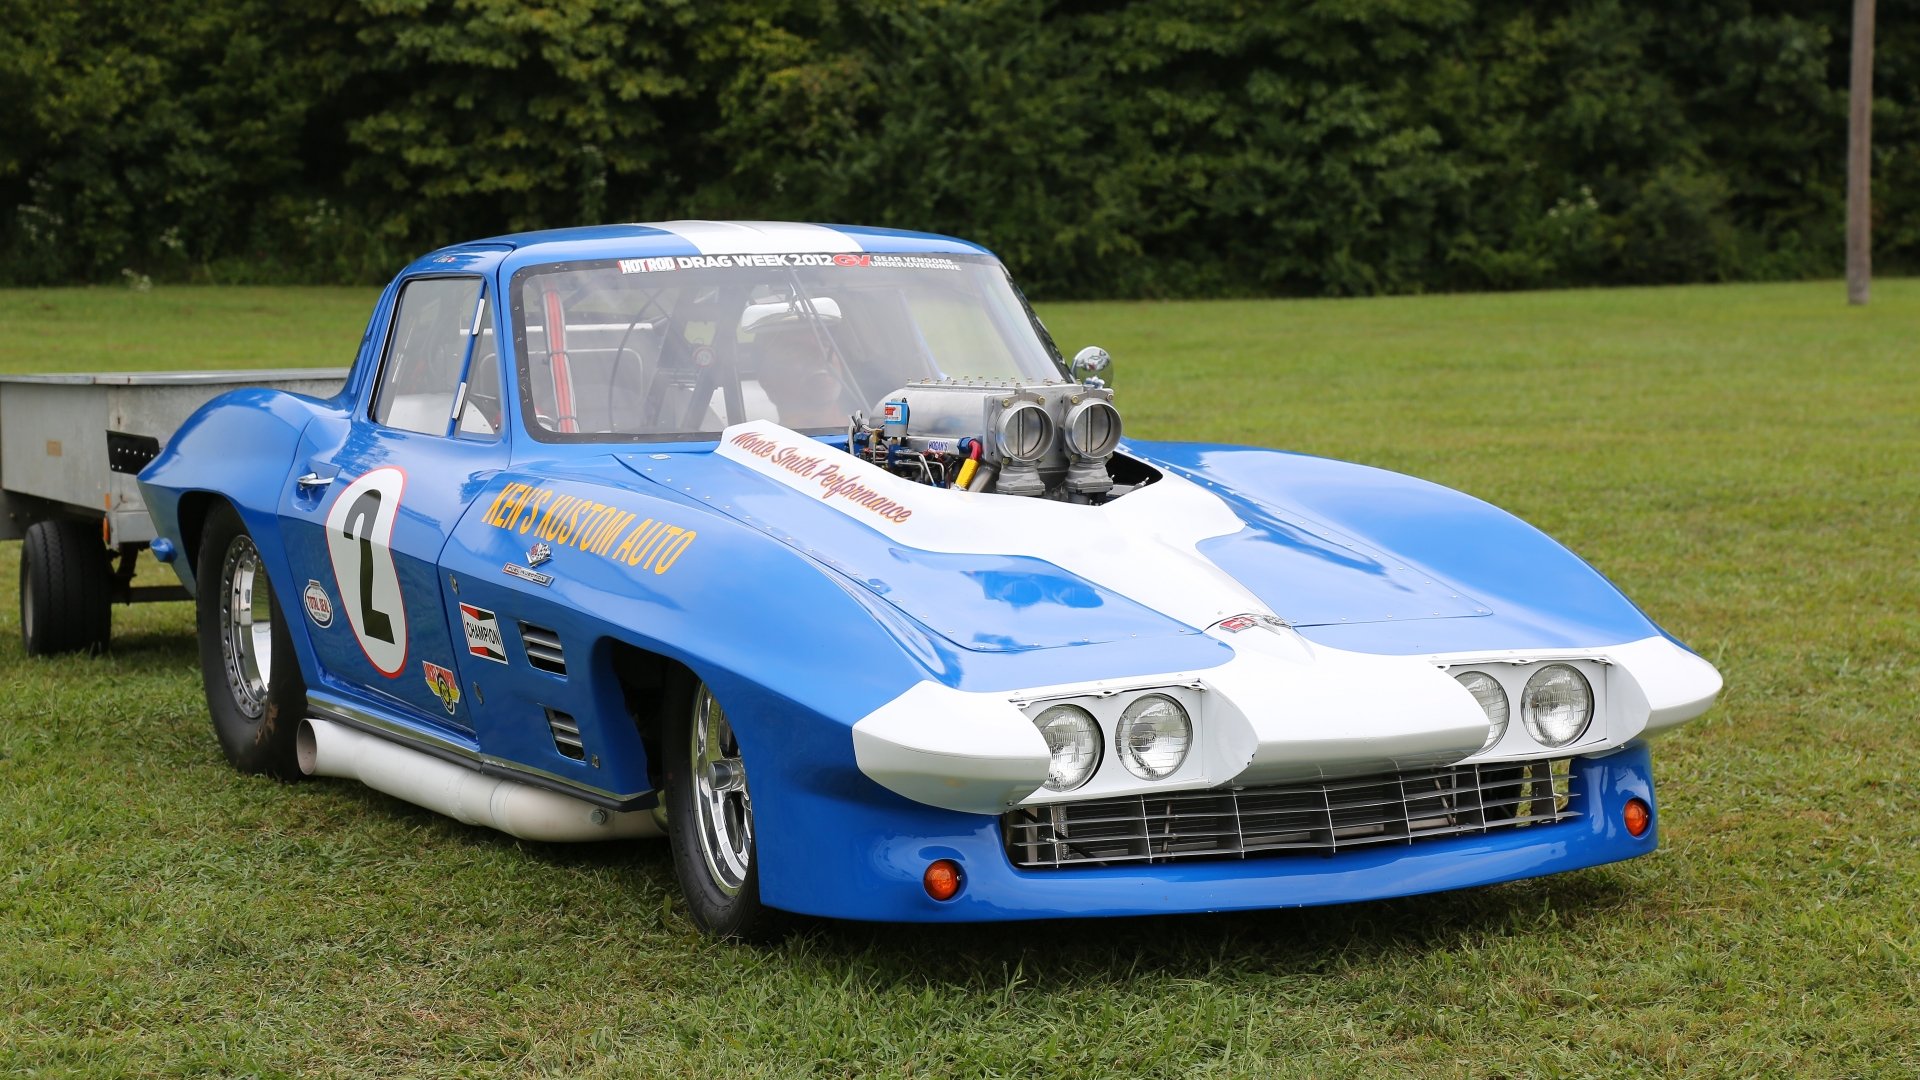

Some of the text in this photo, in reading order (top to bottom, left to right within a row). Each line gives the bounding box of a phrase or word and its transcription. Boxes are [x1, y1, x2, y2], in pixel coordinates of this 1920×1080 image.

[618, 254, 836, 274] HOT ROD DRAG WEEK 2012
[874, 255, 953, 265] GEAR VENDORS
[729, 431, 912, 525] Monte Smith Performance
[481, 482, 697, 576] KEN'S KUSTOM AUTO
[343, 488, 395, 645] 2
[466, 621, 501, 646] CHAMPION
